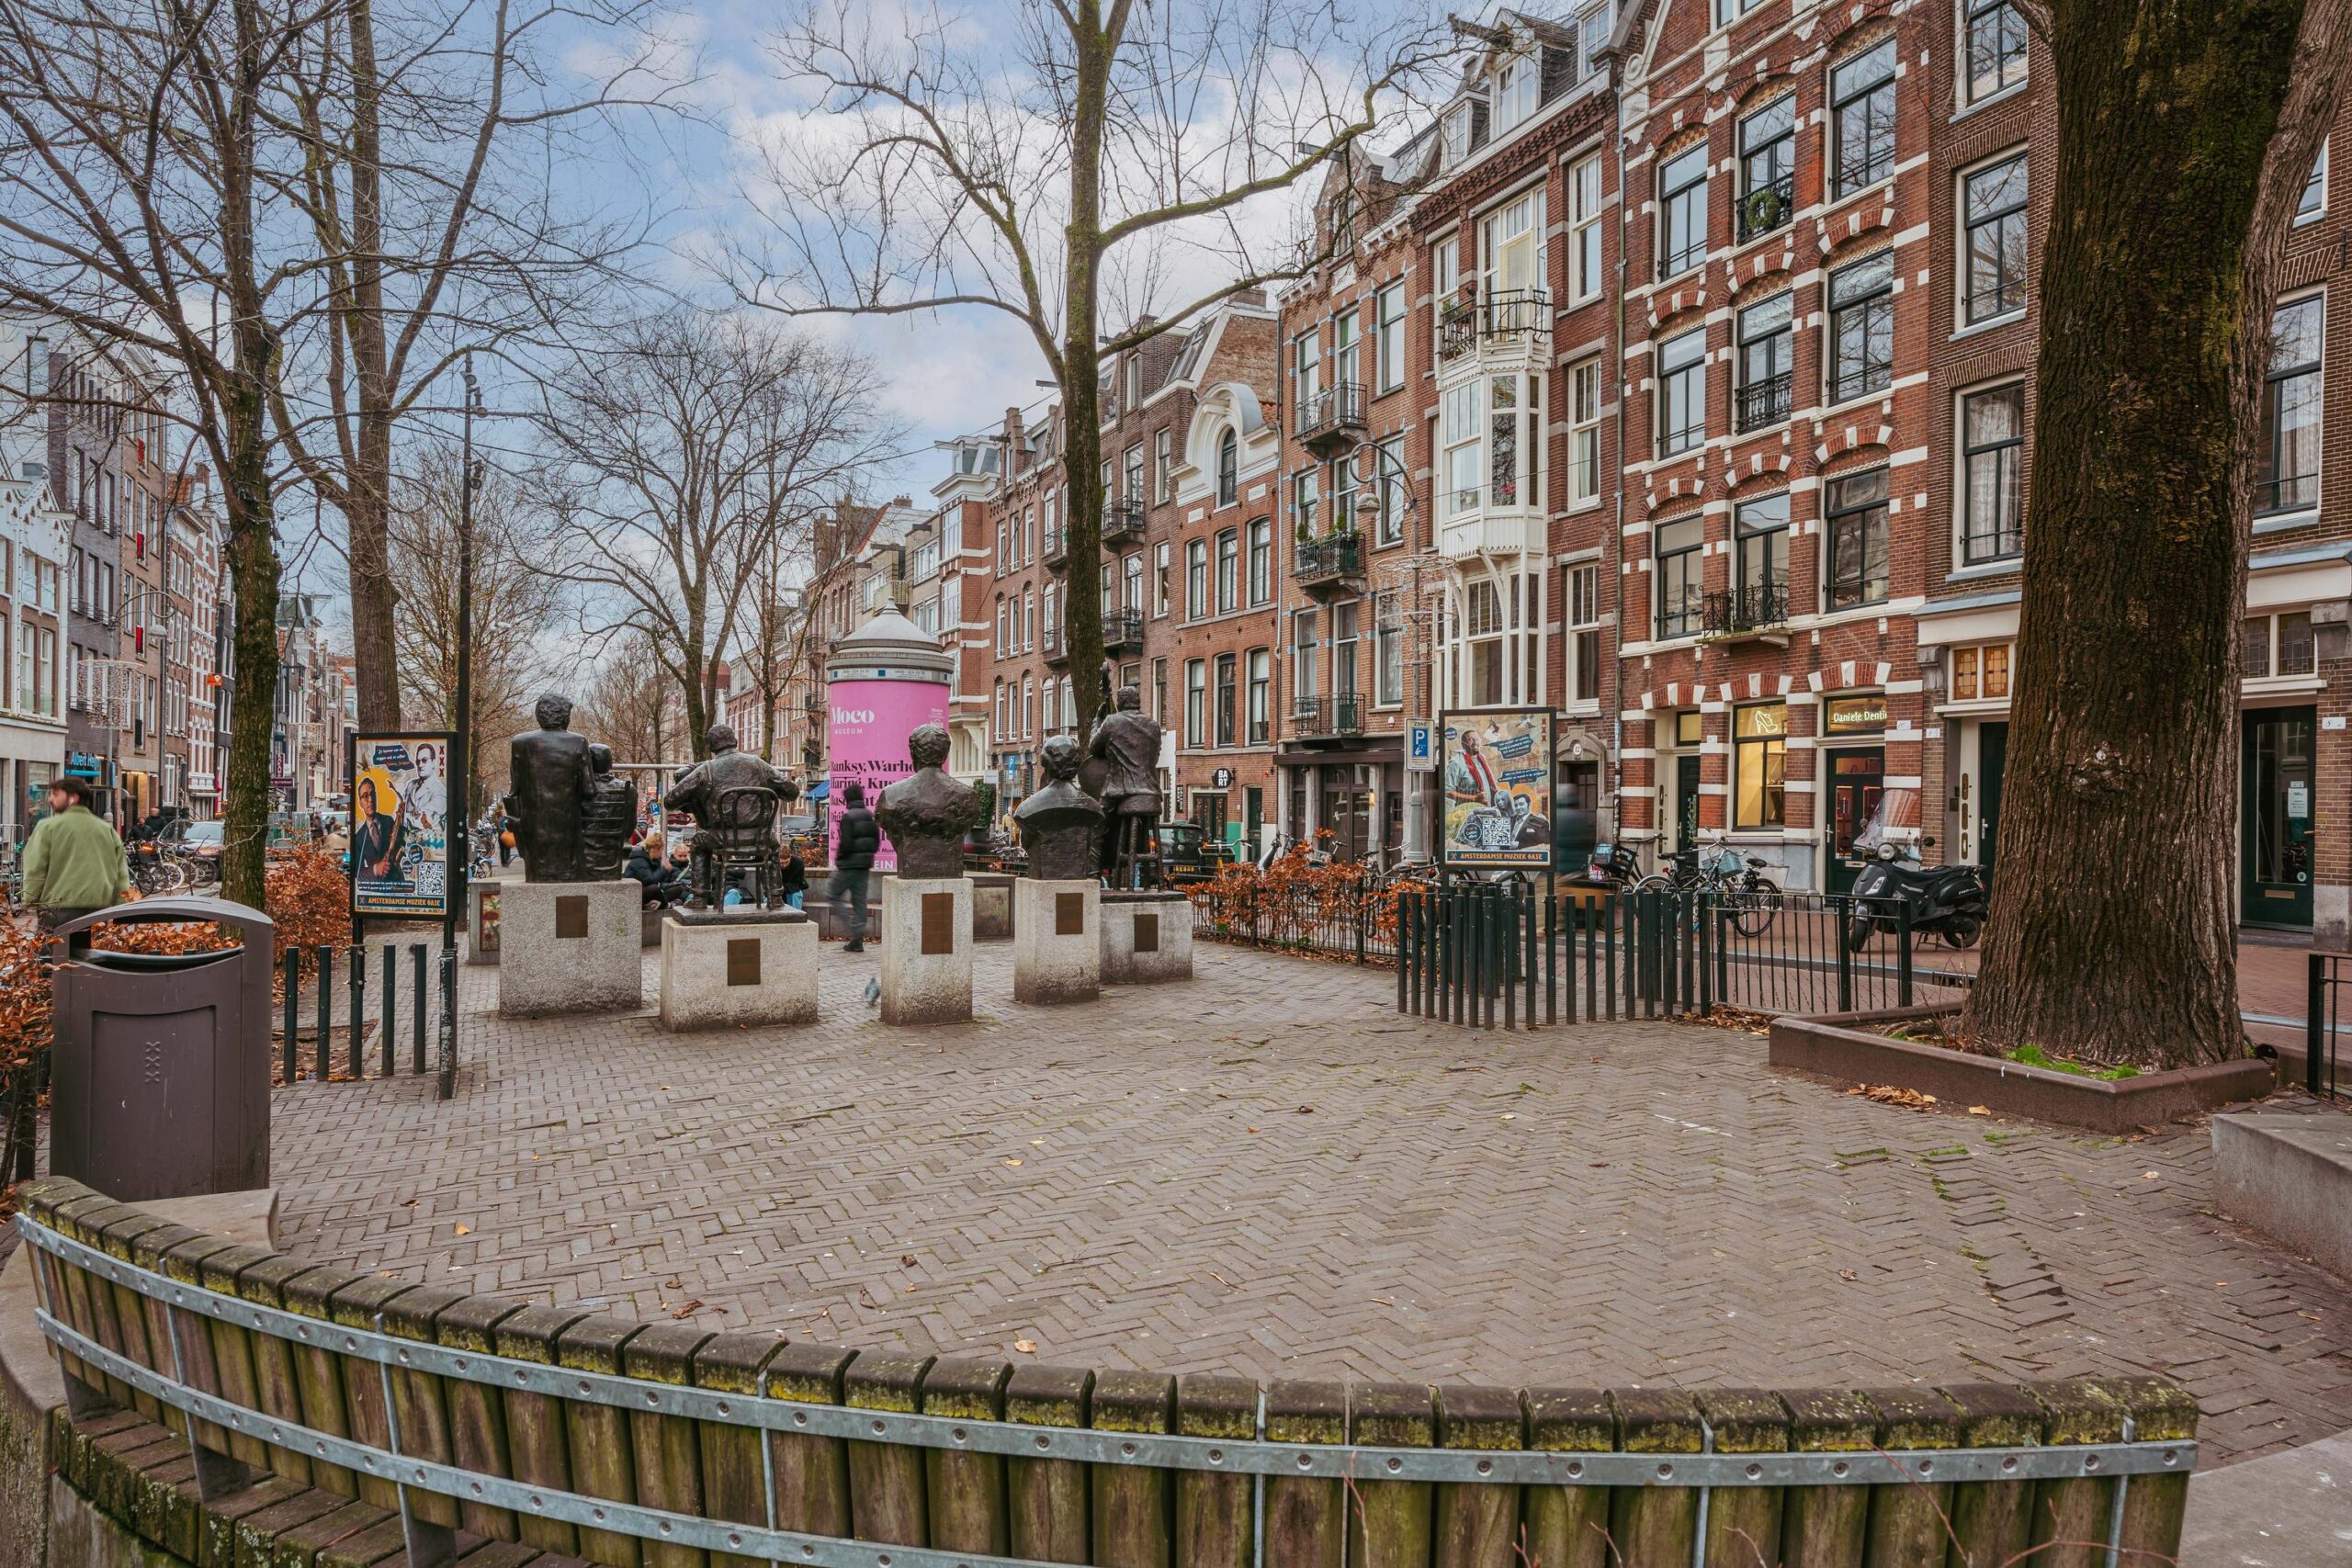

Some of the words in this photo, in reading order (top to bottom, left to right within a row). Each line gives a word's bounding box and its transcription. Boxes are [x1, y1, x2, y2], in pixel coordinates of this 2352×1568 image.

[1833, 711, 1862, 723] Daniele
[1415, 729, 1425, 745] P
[71, 750, 87, 766] Albert
[1218, 770, 1228, 778] BA
[1218, 778, 1228, 787] RT
[651, 803, 658, 811] P
[368, 897, 406, 906] AMSTERDAMSE
